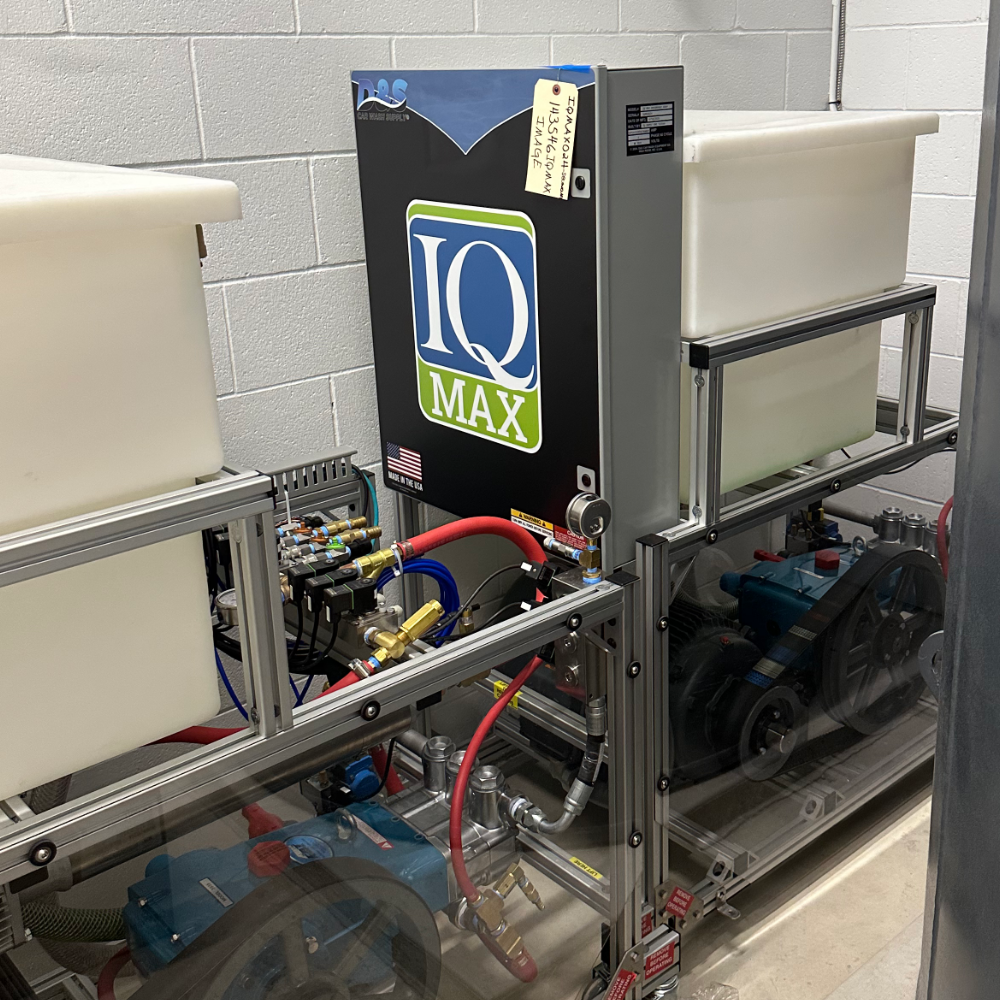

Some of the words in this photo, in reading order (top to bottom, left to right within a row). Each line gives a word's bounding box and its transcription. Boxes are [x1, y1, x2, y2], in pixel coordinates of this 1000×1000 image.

[357, 78, 408, 112] D&S
[531, 116, 544, 168] IMAGE
[413, 233, 534, 390] IQ
[430, 371, 528, 443] MAX
[523, 514, 541, 525] WARNING
[673, 896, 687, 908] BEFORE
[676, 889, 691, 901] REMOVE
[650, 944, 670, 960] REMOVE
[650, 952, 669, 967] BEFORE
[646, 957, 672, 975] OPERATING
[607, 977, 621, 1000] EMOVE
[612, 978, 624, 1000] EFORE
